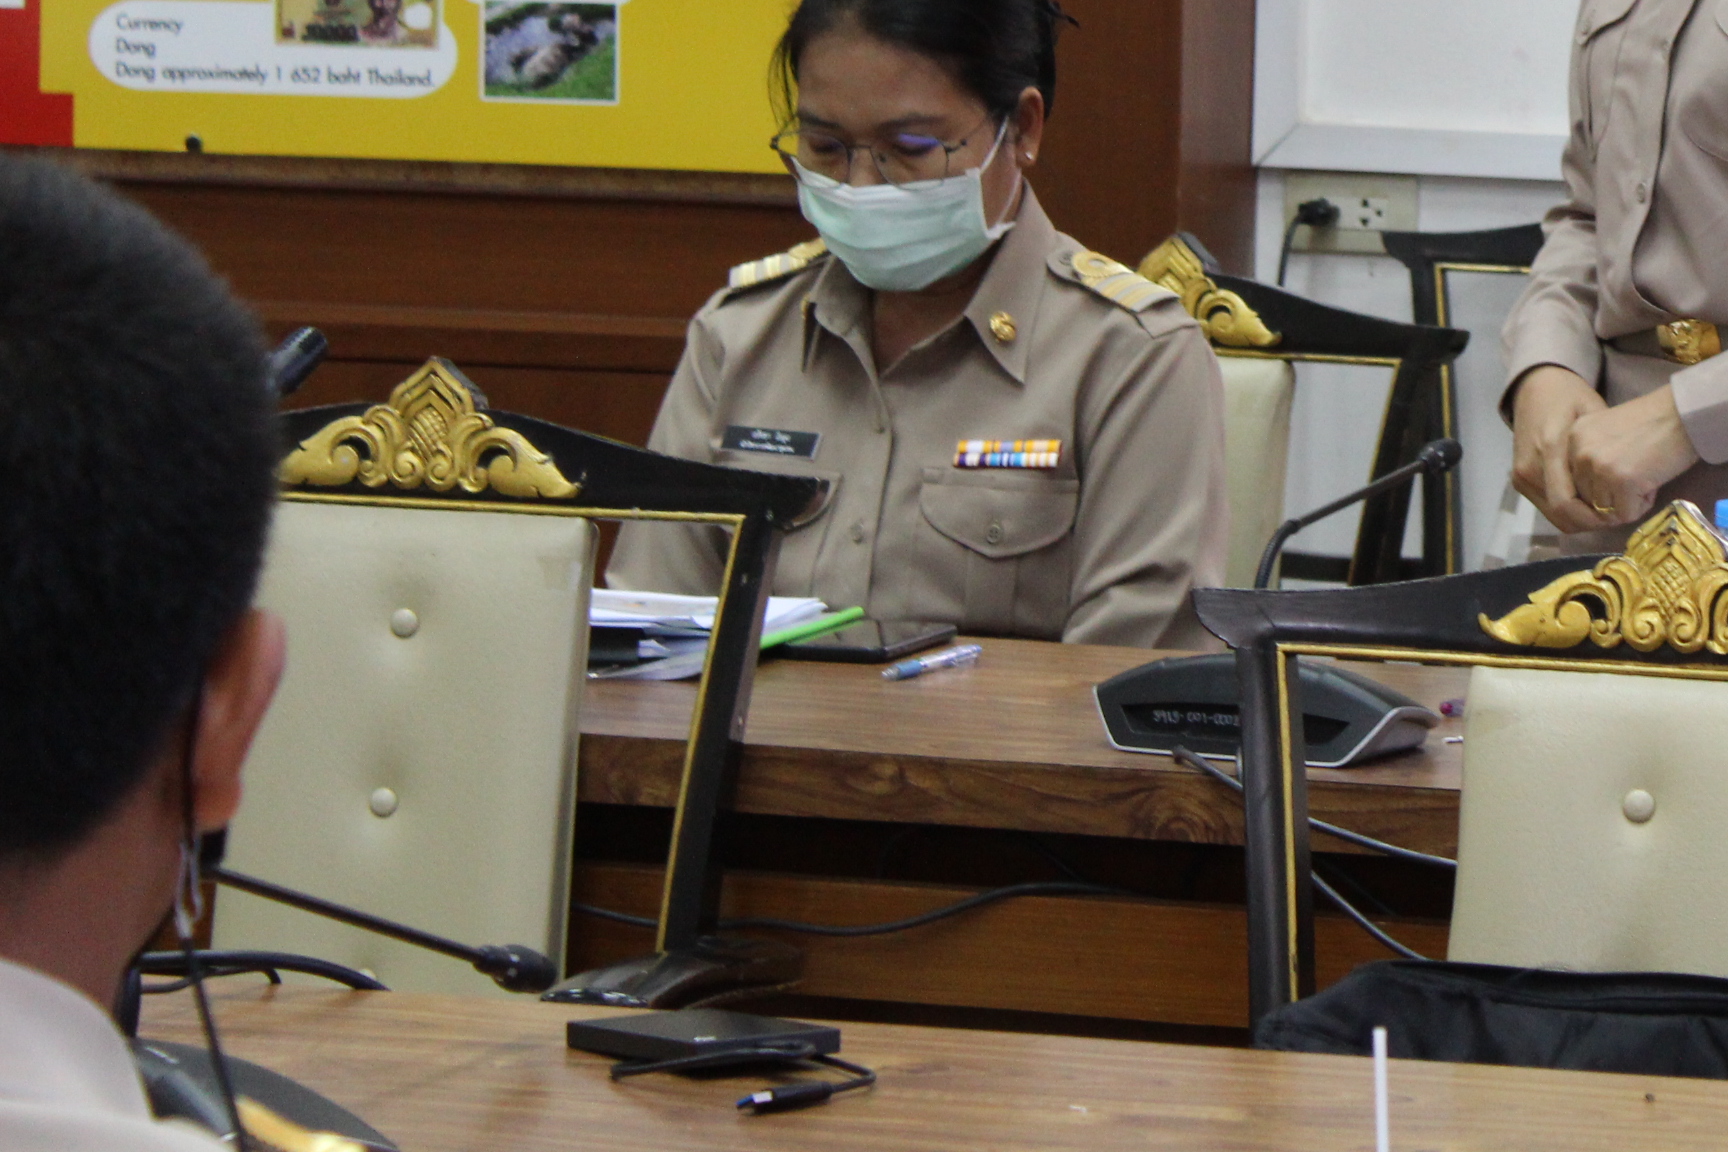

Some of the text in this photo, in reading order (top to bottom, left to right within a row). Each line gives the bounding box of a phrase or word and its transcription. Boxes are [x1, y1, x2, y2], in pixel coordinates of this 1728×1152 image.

[116, 14, 183, 35] Currency
[115, 37, 156, 59] Dong
[115, 60, 156, 83] Dong
[161, 64, 268, 85] approximately
[275, 65, 282, 82] 1
[326, 66, 361, 85] baht
